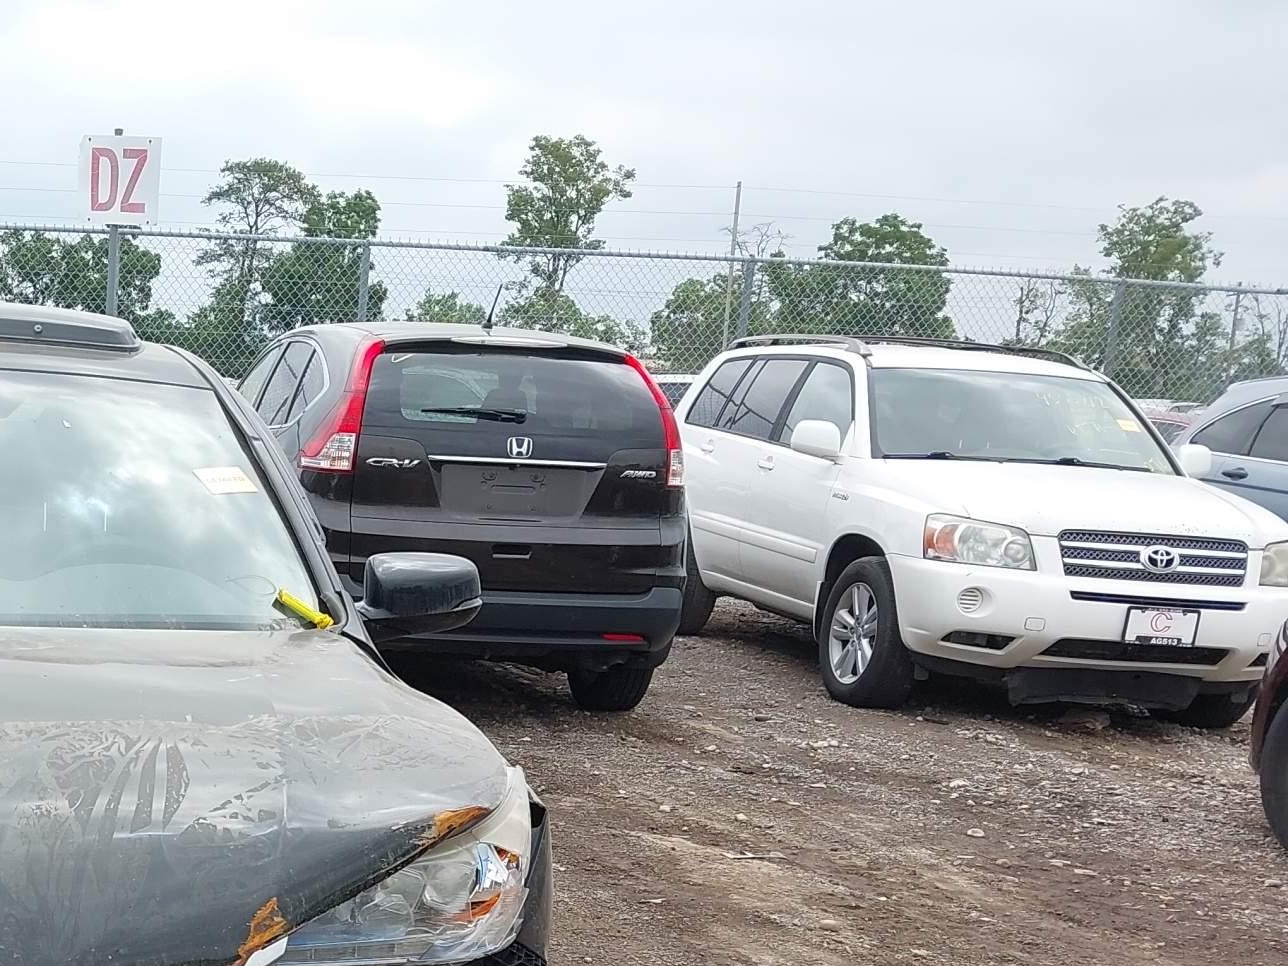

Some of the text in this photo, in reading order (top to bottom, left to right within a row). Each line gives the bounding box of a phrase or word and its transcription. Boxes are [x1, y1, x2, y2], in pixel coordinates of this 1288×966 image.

[91, 147, 148, 213] DZ
[365, 457, 421, 468] CR-V
[620, 470, 657, 479] AWD
